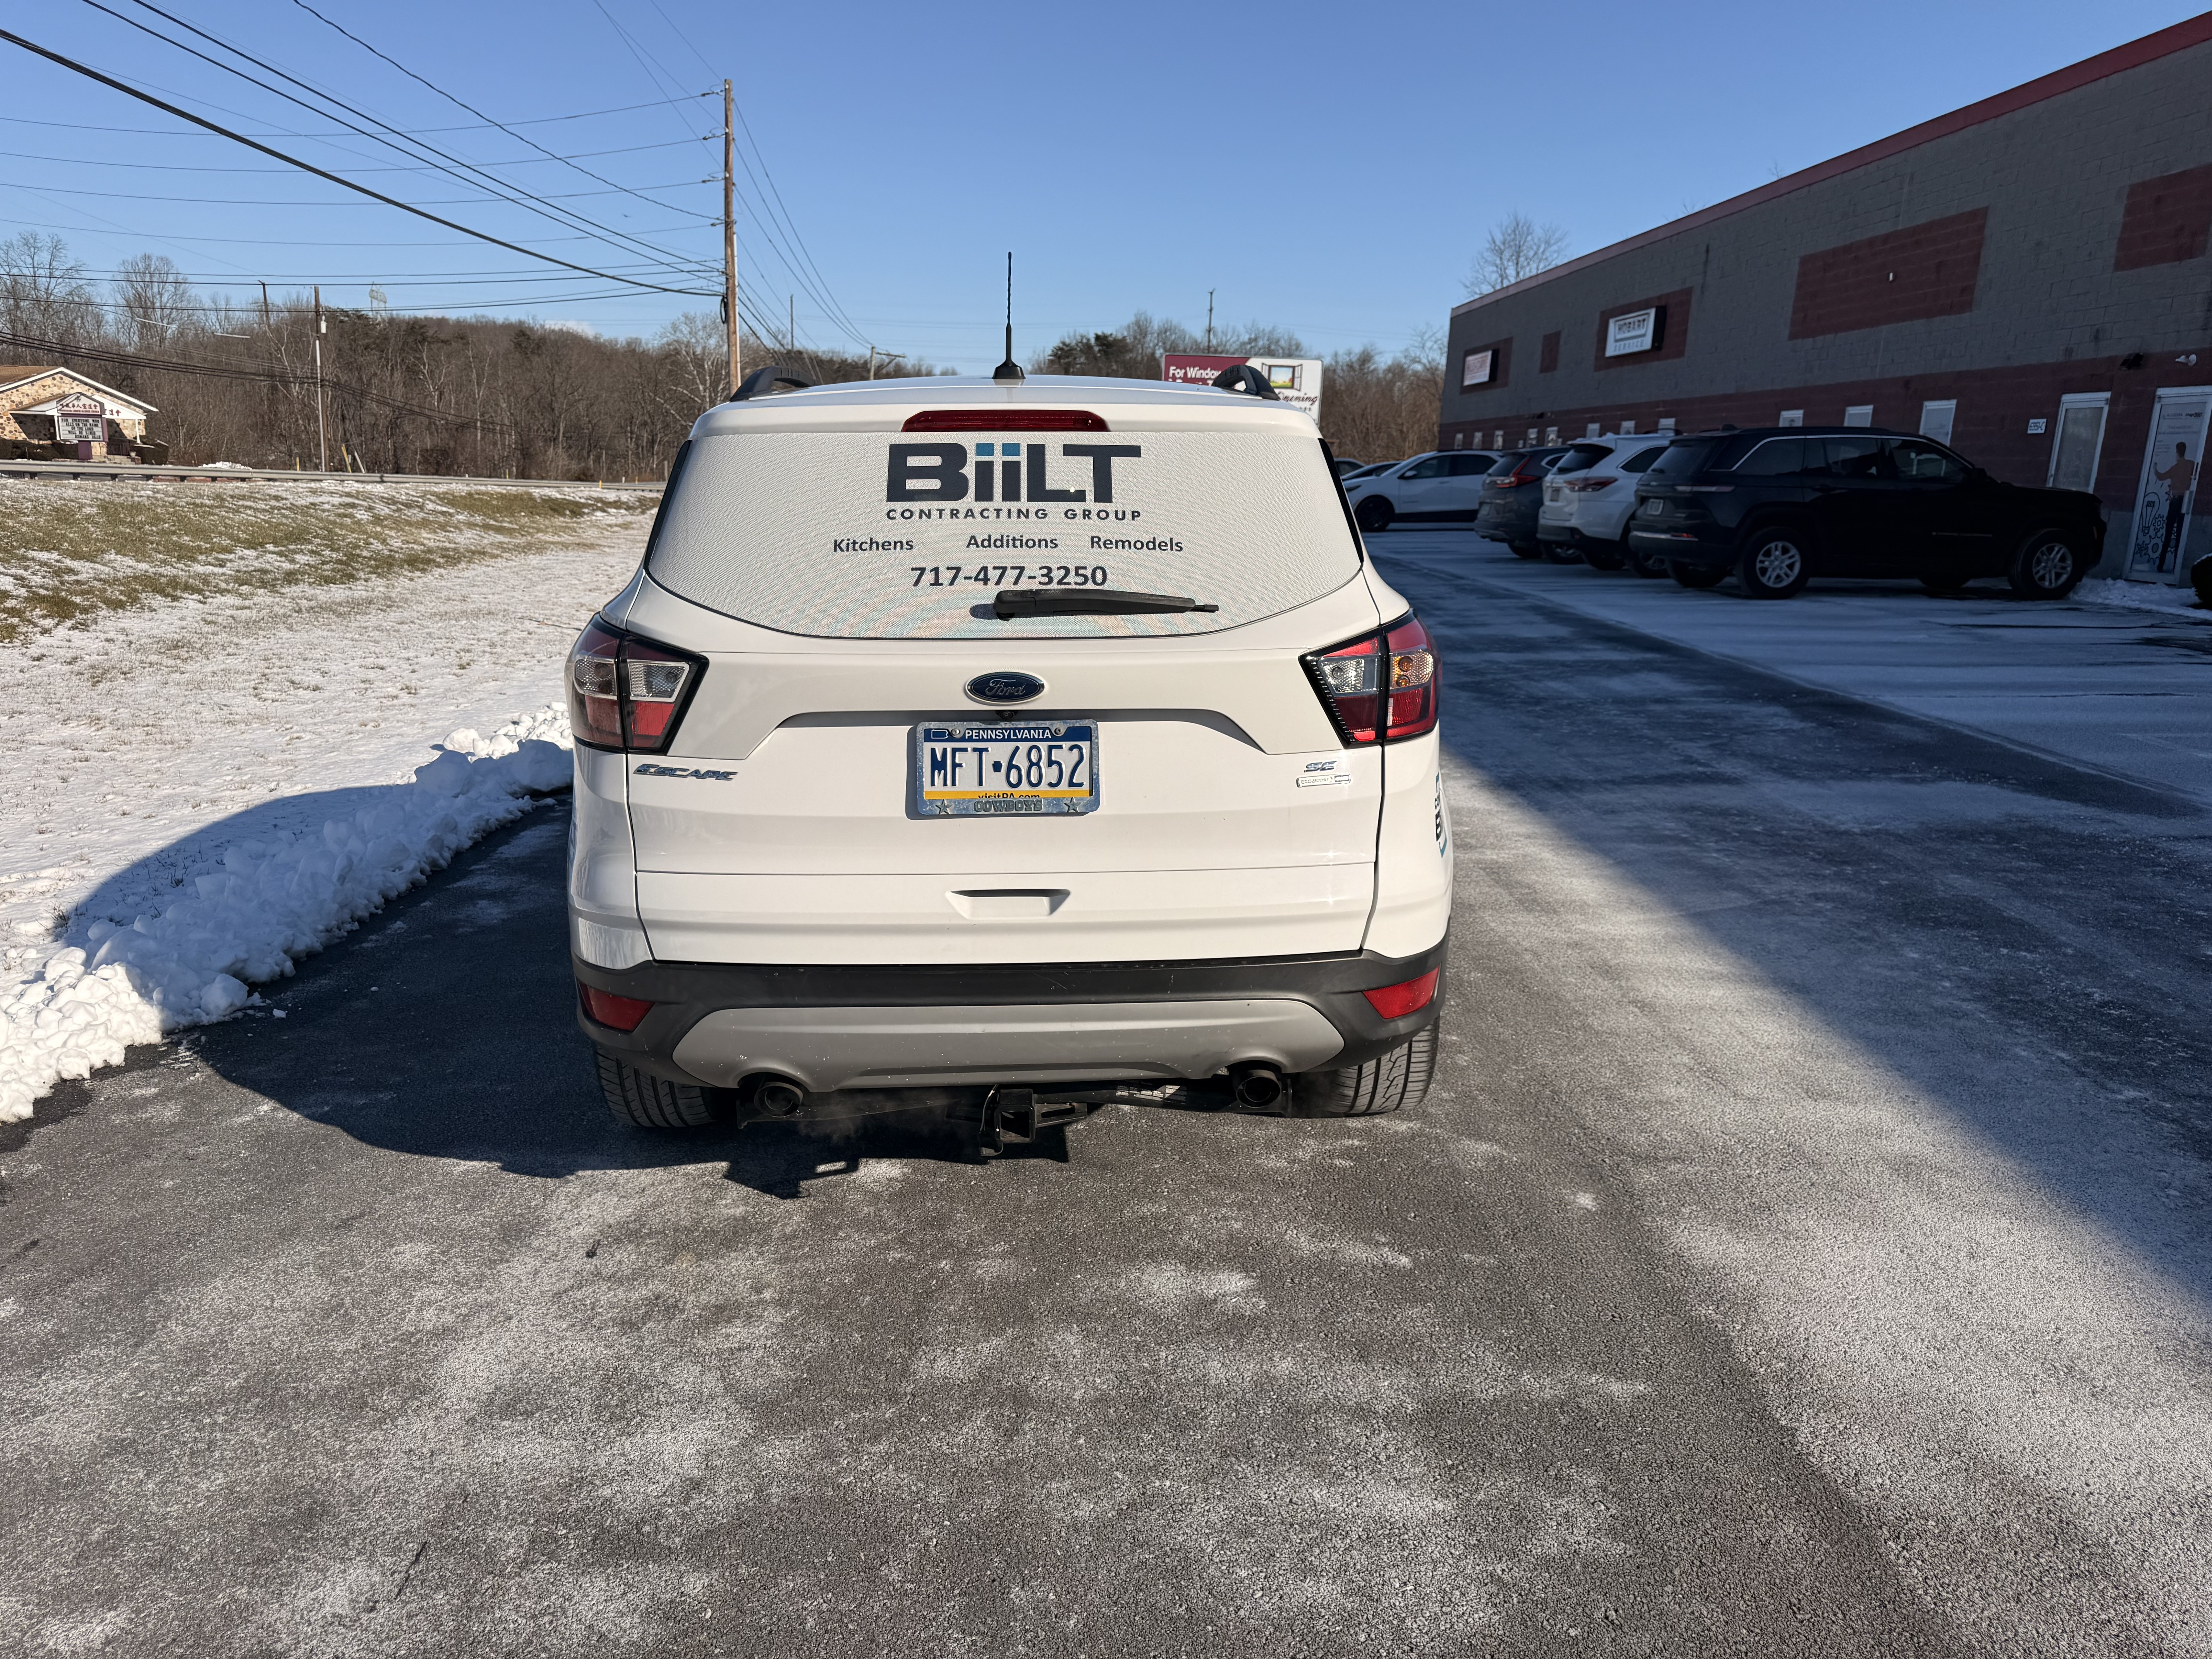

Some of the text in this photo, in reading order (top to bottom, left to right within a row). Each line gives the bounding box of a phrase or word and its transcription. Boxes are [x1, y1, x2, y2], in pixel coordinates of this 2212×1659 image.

[1169, 366, 1185, 378] For
[886, 508, 1142, 522] CONTRACTING GROUP
[833, 534, 1183, 553] Kitchens Additions Remodels
[910, 566, 1108, 587] 717-477-3250
[985, 678, 1026, 696] Ford
[965, 730, 1052, 739] PENNSYLVANIA
[633, 763, 738, 781] ESCAPE
[1304, 761, 1337, 773] SE
[974, 799, 1043, 812] COWBOYS
